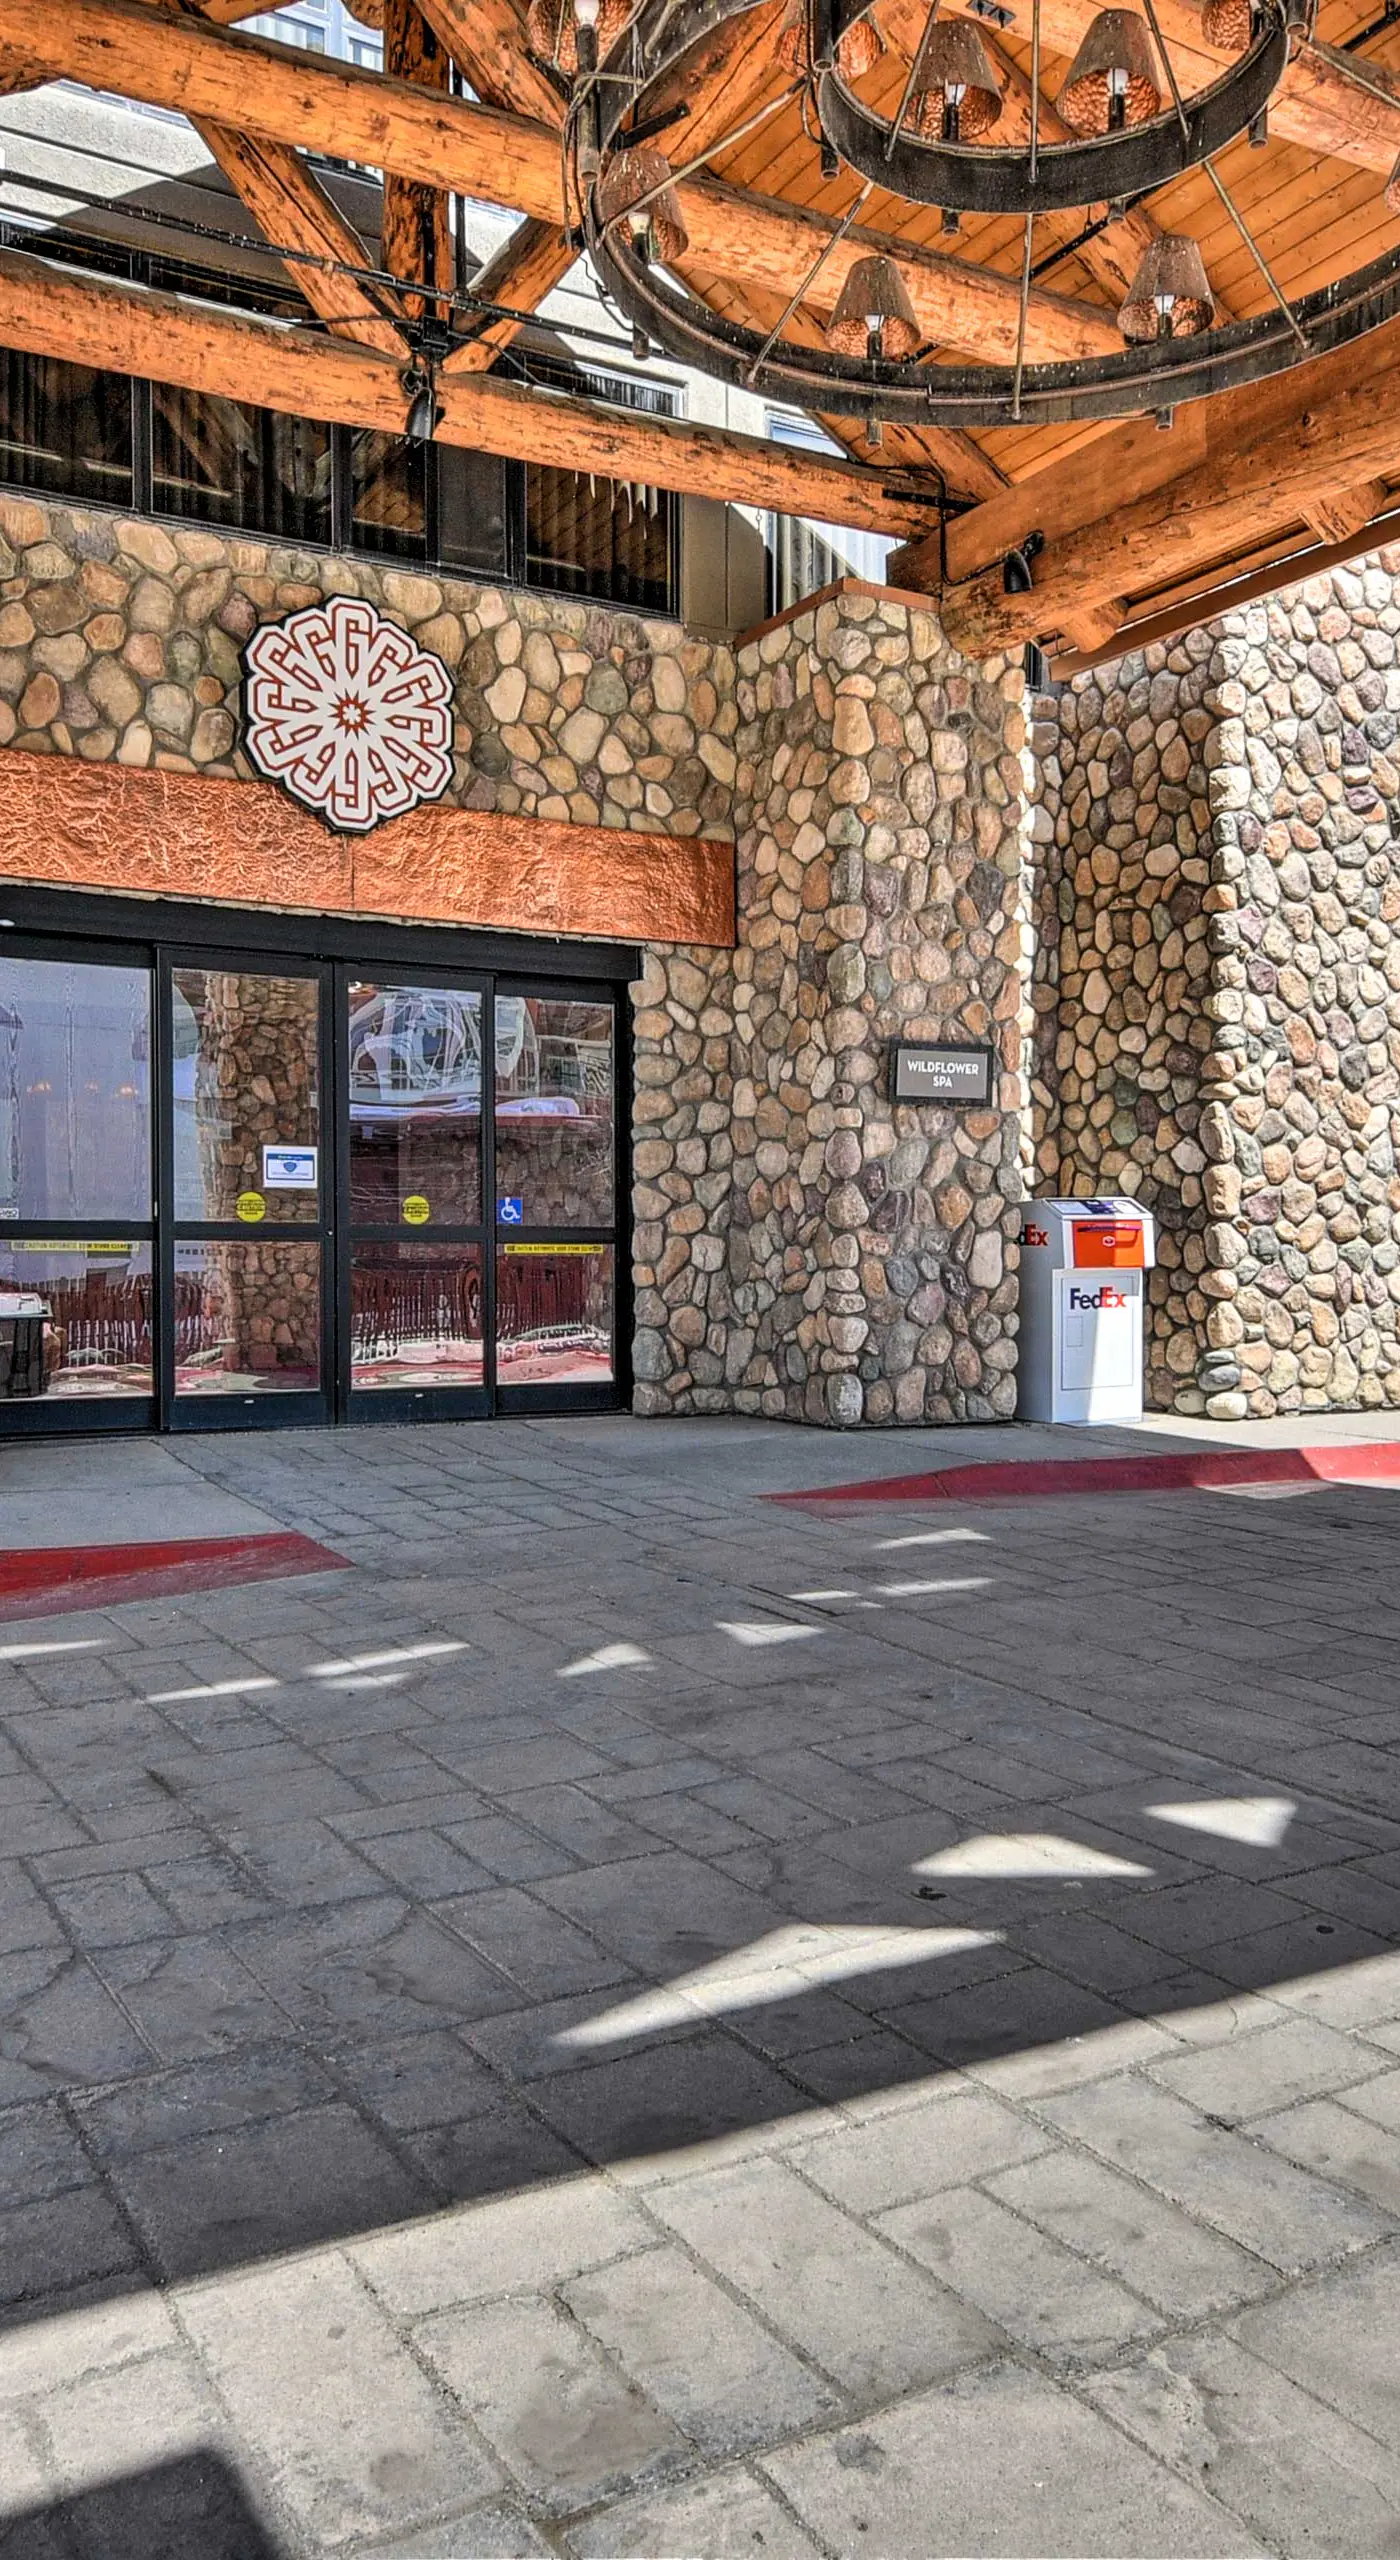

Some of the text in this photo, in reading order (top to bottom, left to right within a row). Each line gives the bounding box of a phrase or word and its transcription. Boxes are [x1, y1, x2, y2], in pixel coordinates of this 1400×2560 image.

[907, 1060, 979, 1076] WILDFLOWER
[932, 1075, 953, 1088] SPA
[1014, 1224, 1048, 1246] dEx
[1070, 1287, 1126, 1310] FedEx
